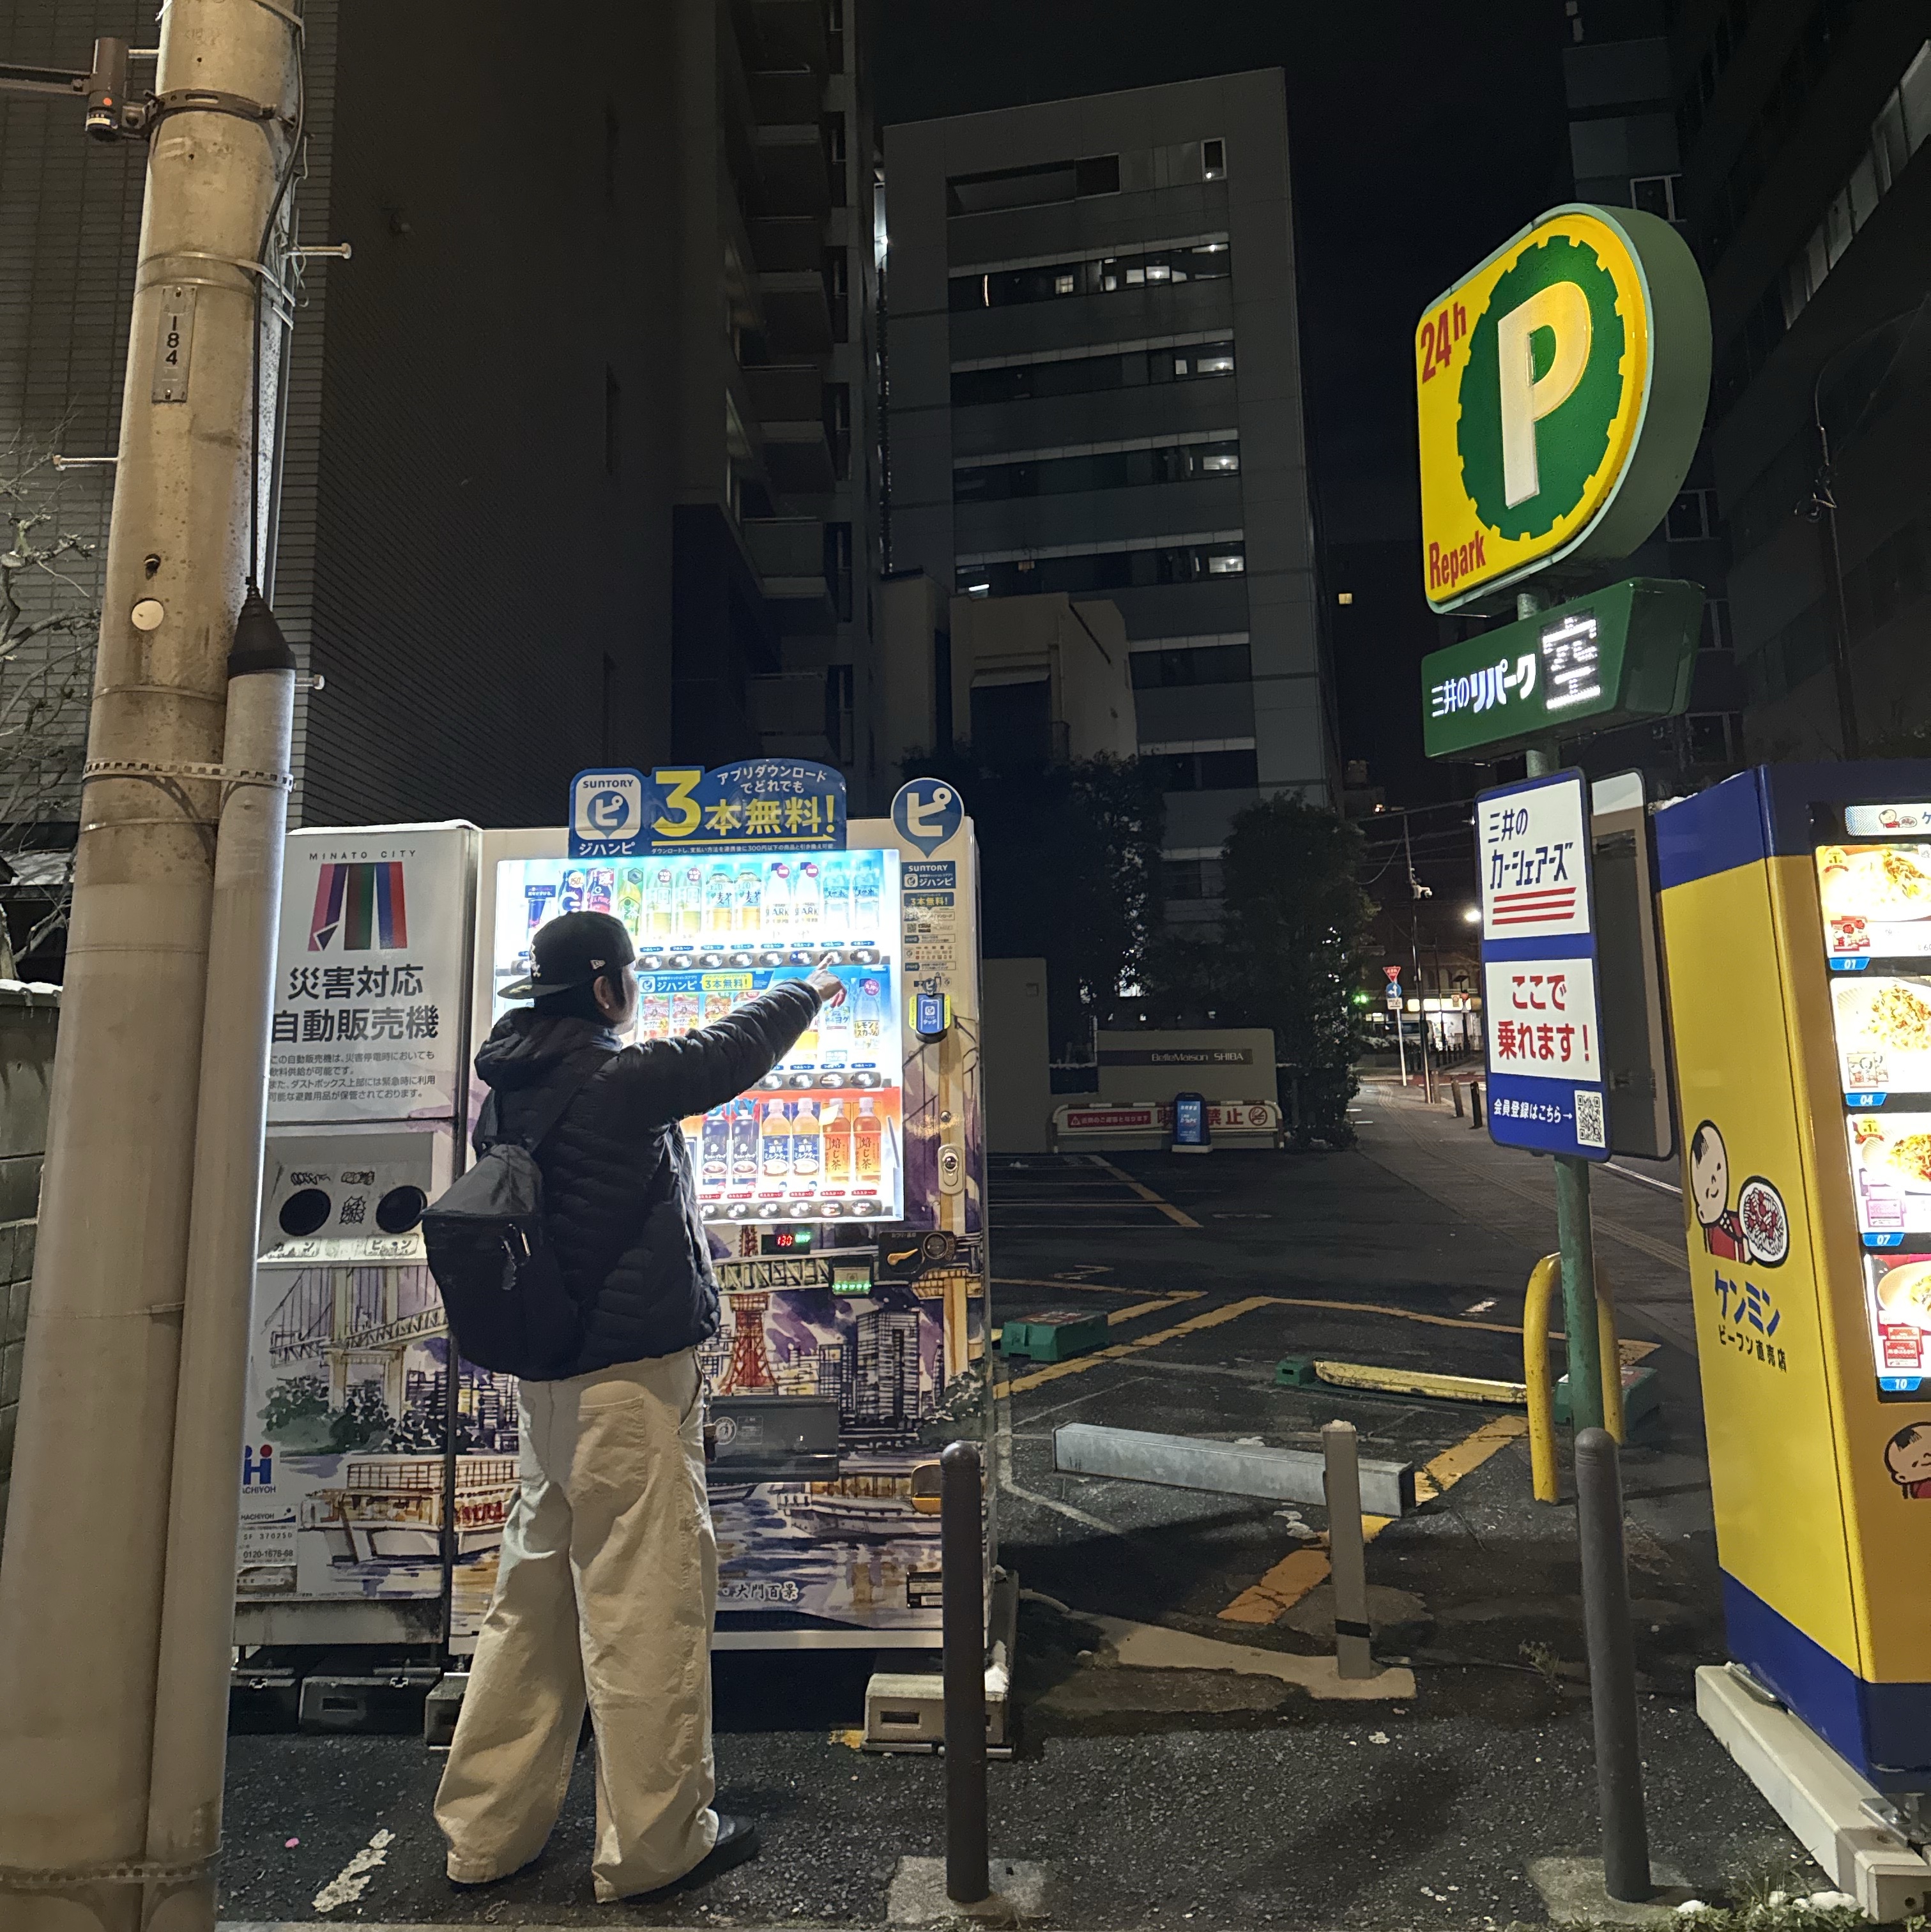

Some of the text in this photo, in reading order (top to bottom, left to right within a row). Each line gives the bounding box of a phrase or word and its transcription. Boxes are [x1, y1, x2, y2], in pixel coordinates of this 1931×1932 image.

[166, 316, 179, 366] 184
[1420, 301, 1467, 384] 24h
[1498, 281, 1592, 509] P
[1429, 529, 1486, 590] Repark
[1543, 616, 1601, 710] 空
[1431, 653, 1536, 717] 三井のリパーク
[583, 779, 634, 789] SUNTORY
[717, 765, 827, 785] アプリダウンロード
[740, 780, 804, 794] でどれでも
[1488, 808, 1529, 843] 三井の
[309, 849, 416, 861] MINATO CITY
[579, 841, 636, 856] ジハンピ
[1490, 842, 1573, 890] カーシェアーズ
[919, 878, 954, 886] ジハンピ
[1843, 959, 1857, 969] 01
[287, 964, 424, 1001] 災害対応
[657, 980, 698, 991] ジハンピ
[1512, 974, 1567, 1011] ここで
[271, 1005, 439, 1044] 自動販売機
[1152, 1053, 1244, 1062] BelleMaison SHIBA
[1860, 1095, 1874, 1105] 04
[777, 1235, 793, 1246] 130
[1877, 1235, 1891, 1245] 07
[1714, 1269, 1781, 1338] ケンミン
[1718, 1324, 1787, 1374] ビーフン直売店
[1895, 1378, 1907, 1389] 10
[735, 1582, 798, 1601] 大門百景
